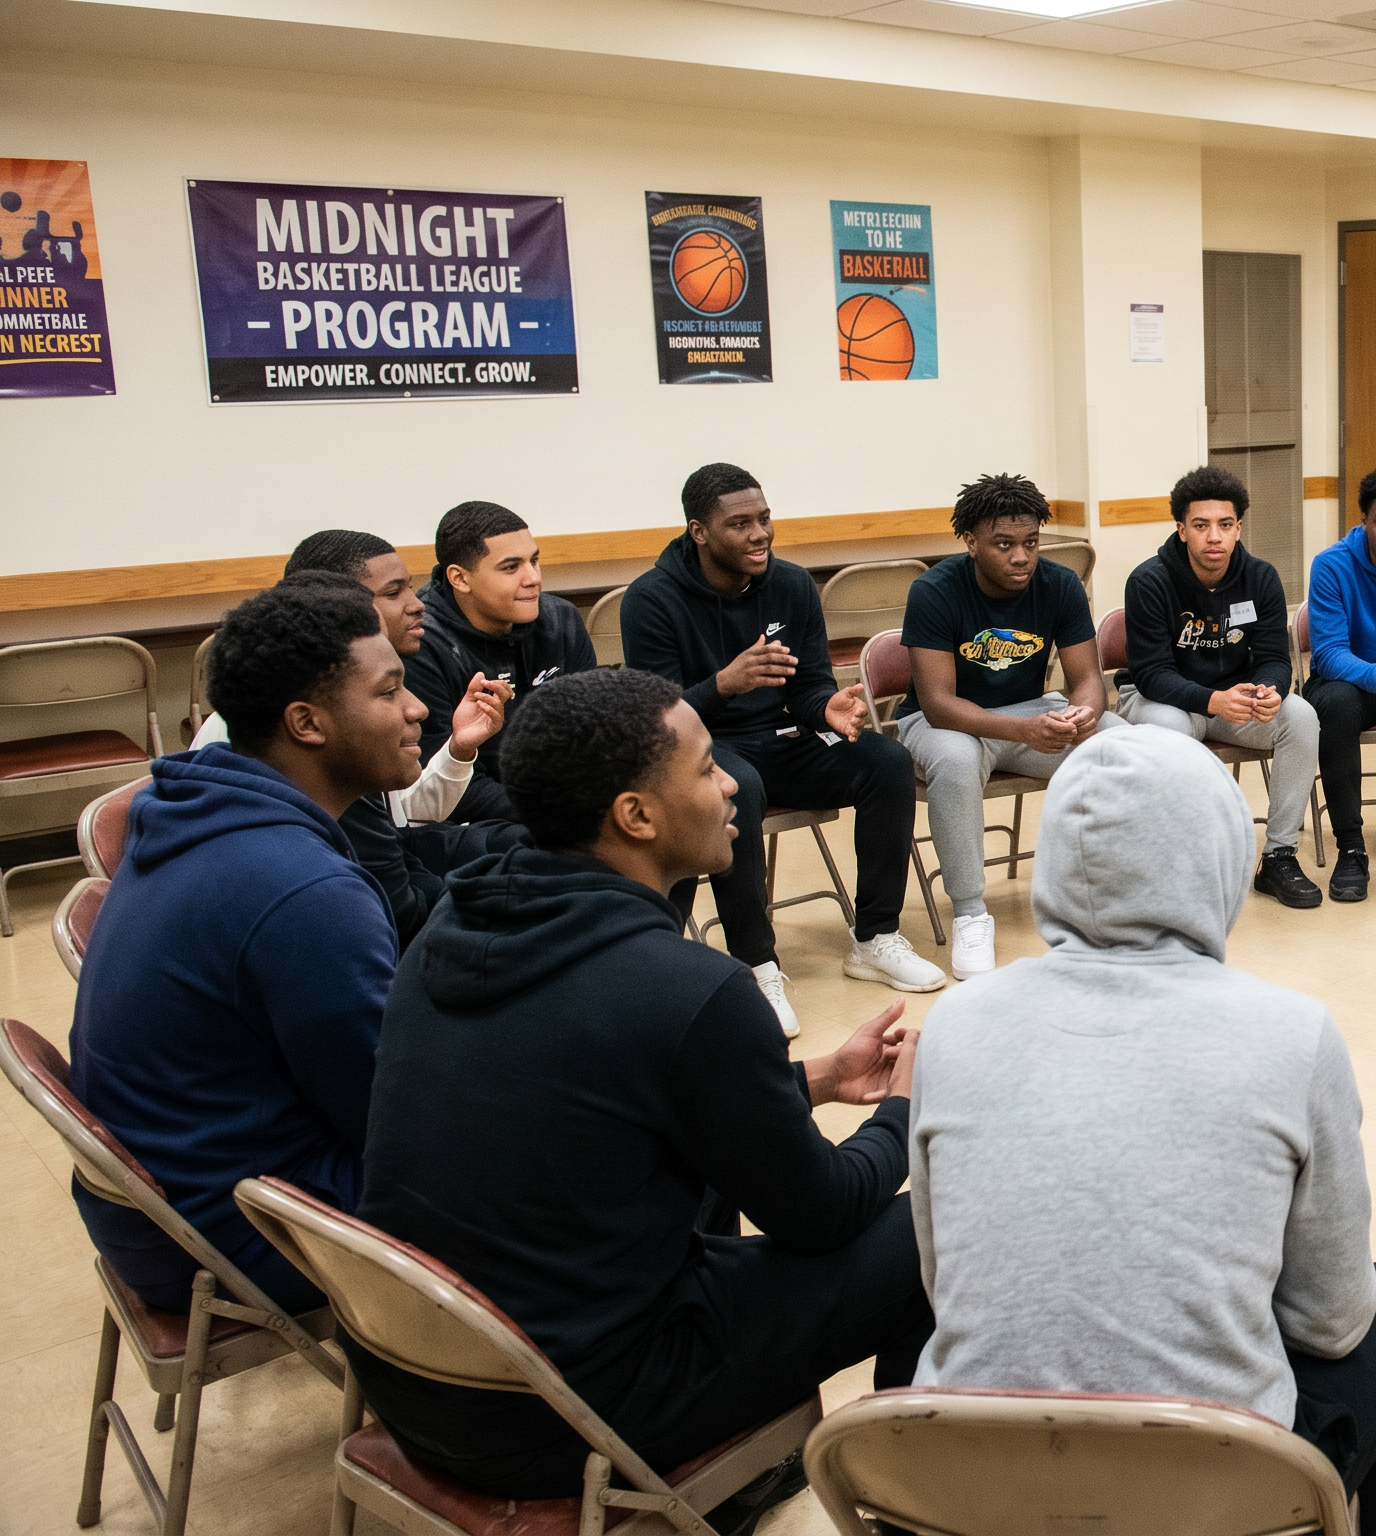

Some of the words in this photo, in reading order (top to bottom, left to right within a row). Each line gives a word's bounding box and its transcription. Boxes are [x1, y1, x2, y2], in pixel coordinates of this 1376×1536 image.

[256, 198, 515, 258] MIDNIGHT
[865, 229, 883, 248] TO
[16, 266, 56, 283] PEFE
[256, 261, 424, 292] BASKETBALL
[430, 264, 523, 293] LEAGUE
[281, 300, 511, 350] PROGRAM
[19, 333, 102, 353] NECREST
[264, 364, 376, 388] EMPOWER.
[379, 362, 472, 385] CONNECT.
[474, 361, 537, 383] GROW.
